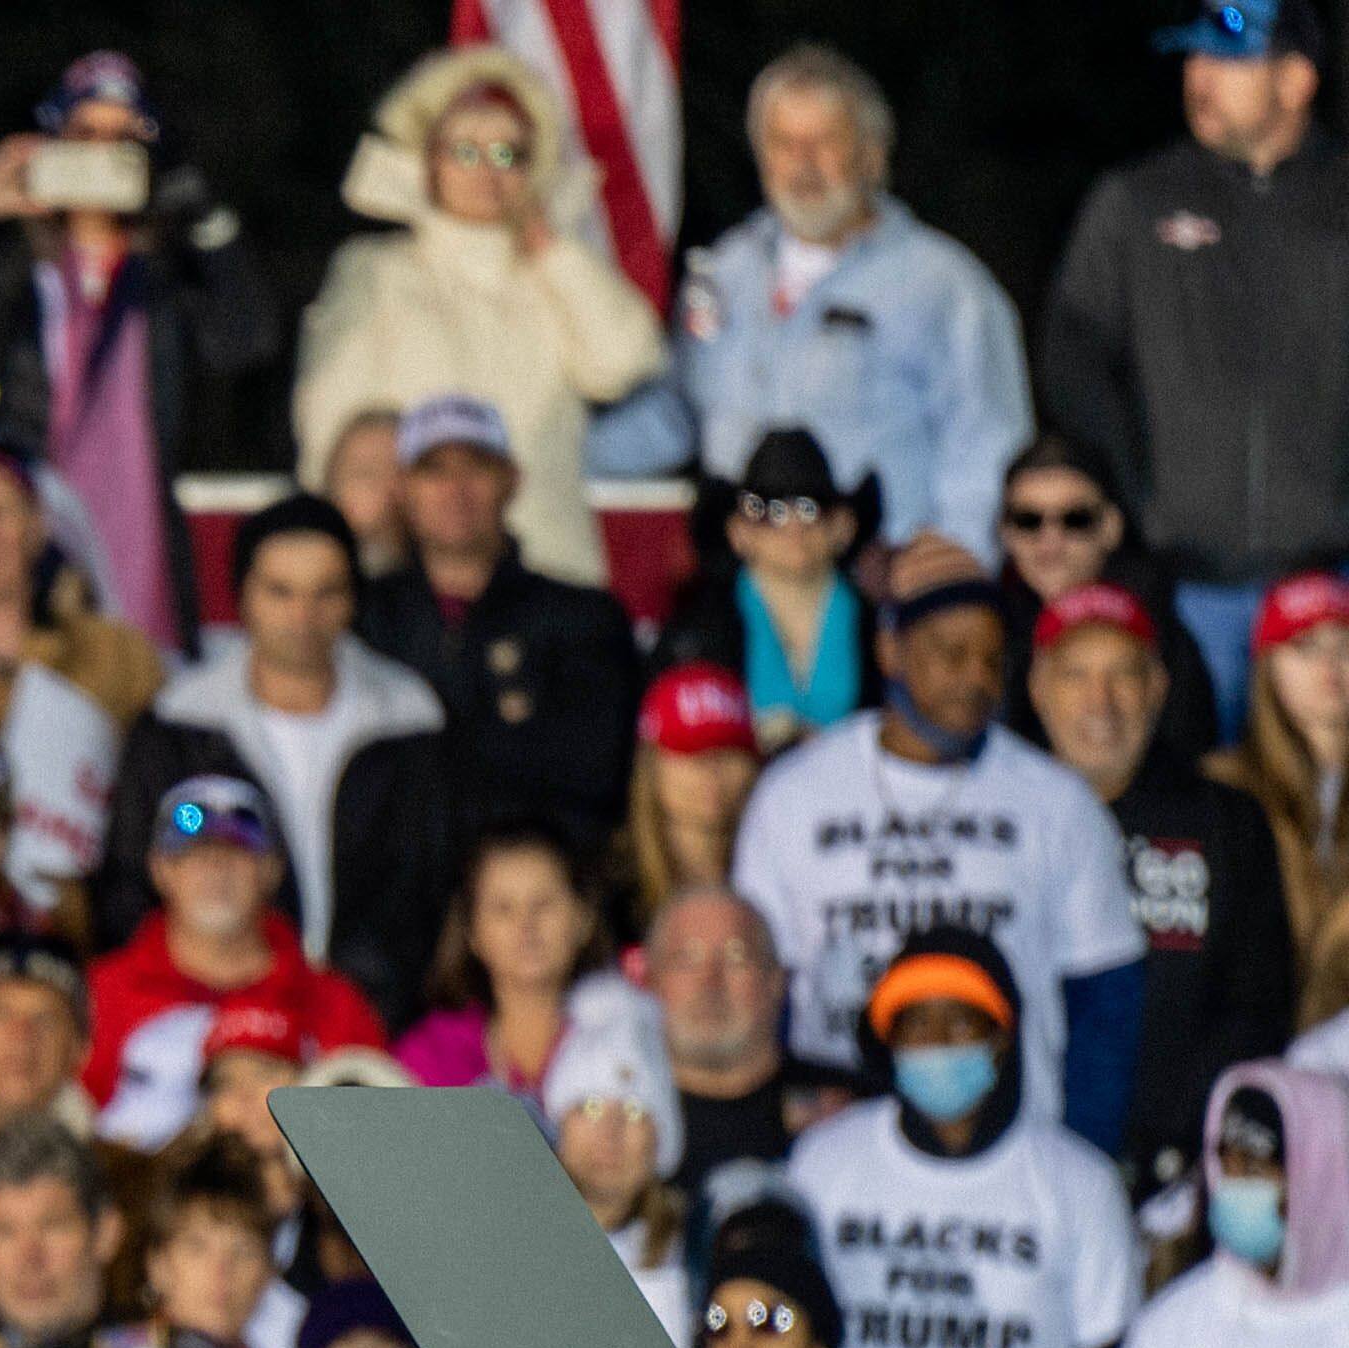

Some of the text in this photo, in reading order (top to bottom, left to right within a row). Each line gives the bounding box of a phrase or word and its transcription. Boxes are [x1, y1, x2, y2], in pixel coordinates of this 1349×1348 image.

[816, 811, 1017, 850] BLACKS
[871, 856, 953, 878] FOR
[839, 1213, 1040, 1264] BLACKS
[887, 1267, 973, 1296] FOR
